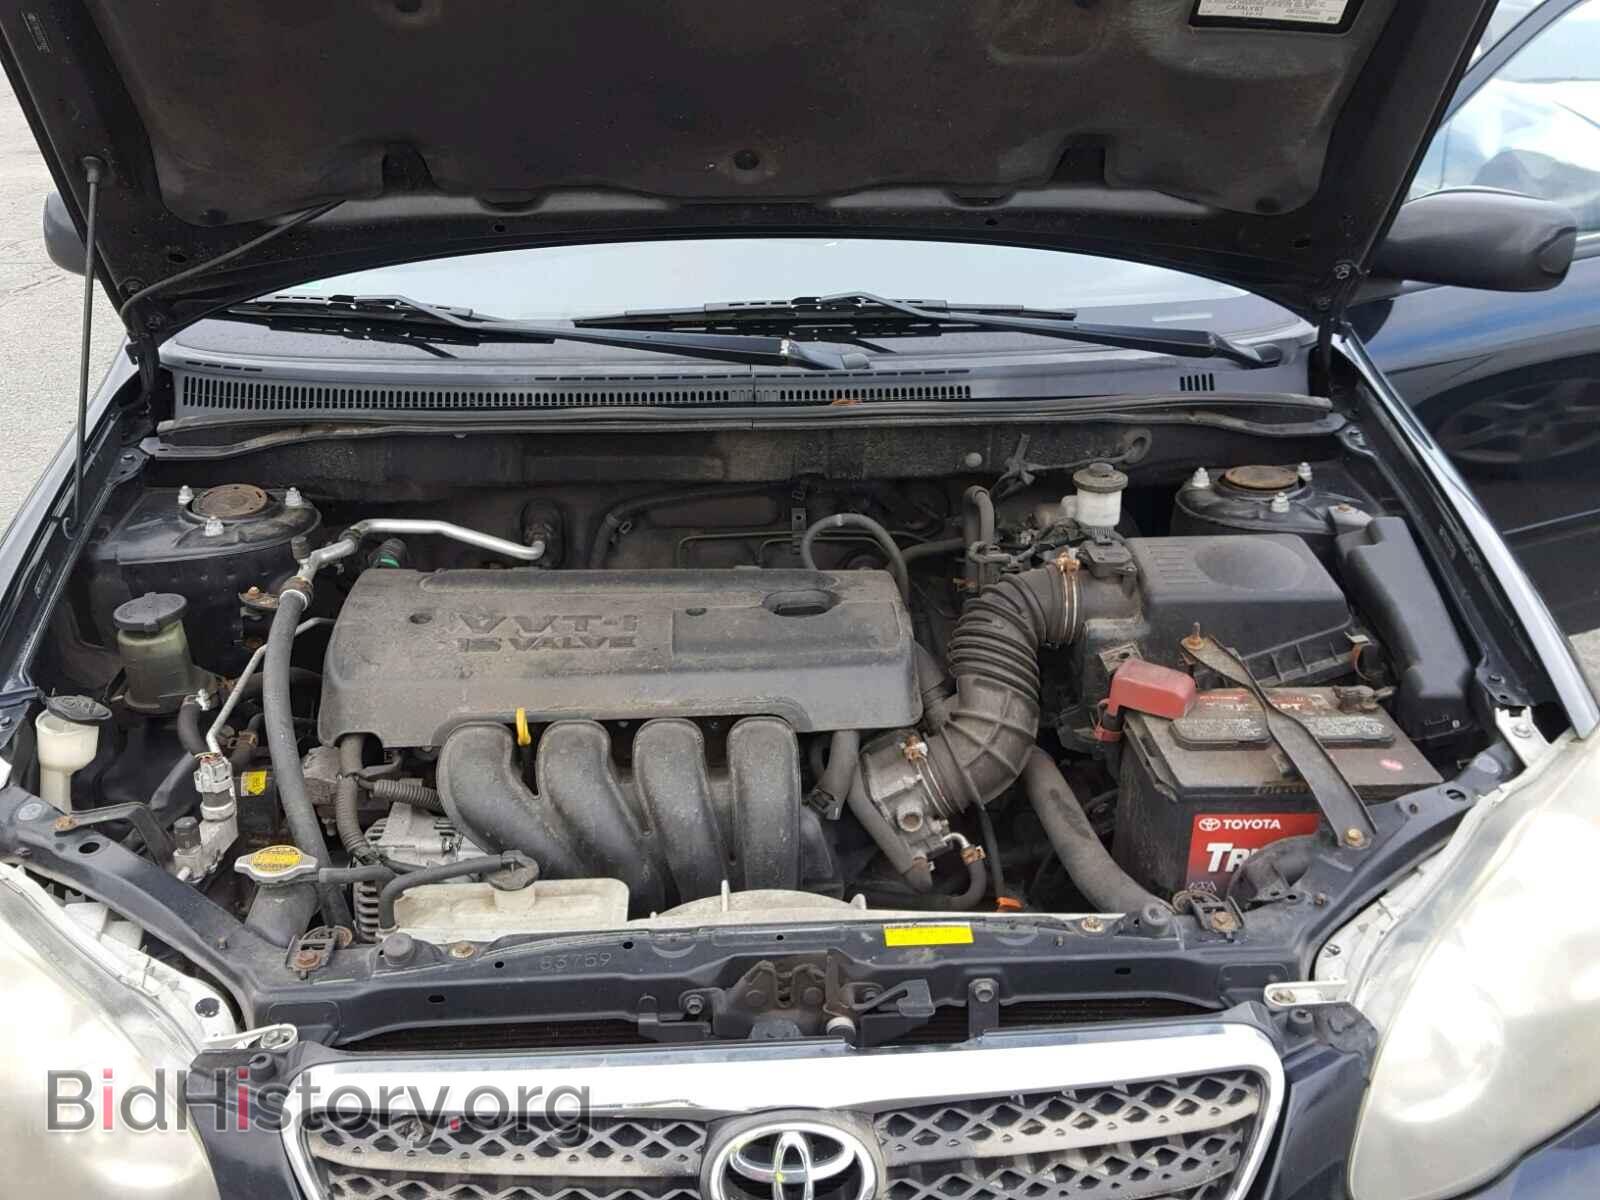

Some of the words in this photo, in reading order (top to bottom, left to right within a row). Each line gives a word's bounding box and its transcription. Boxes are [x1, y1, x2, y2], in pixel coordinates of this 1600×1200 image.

[507, 637, 637, 652] VALVE
[1222, 818, 1281, 830] TOYOTA
[1206, 842, 1260, 873] TR
